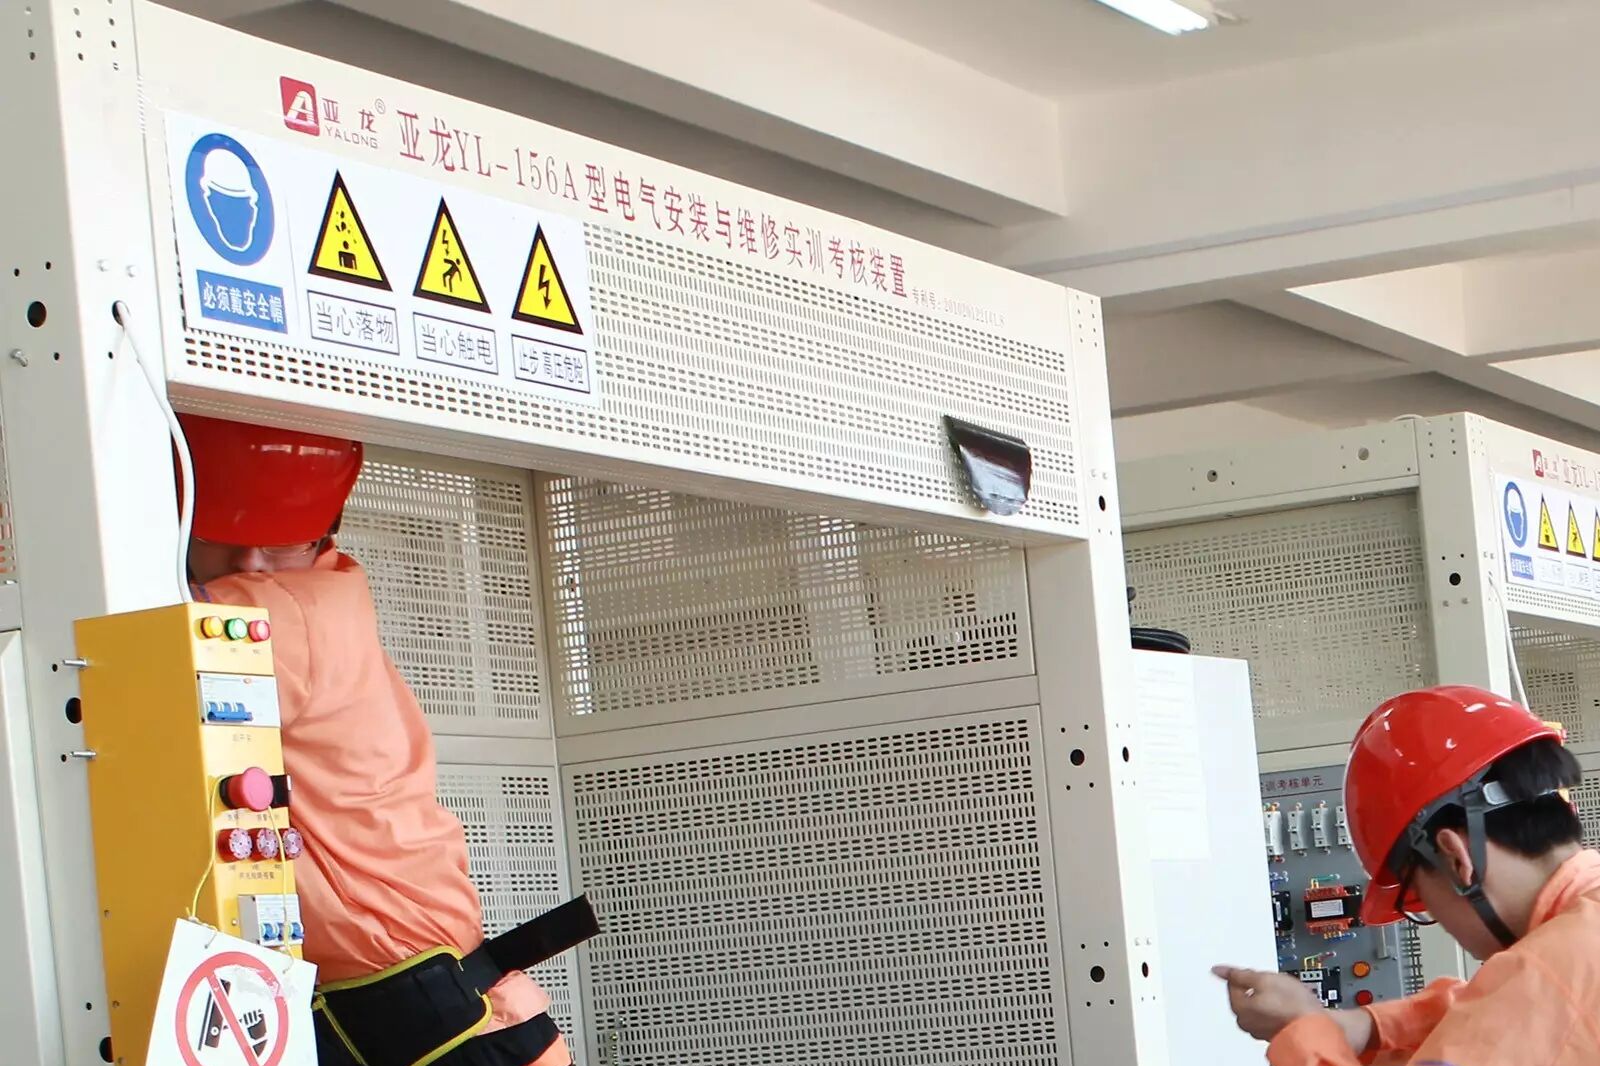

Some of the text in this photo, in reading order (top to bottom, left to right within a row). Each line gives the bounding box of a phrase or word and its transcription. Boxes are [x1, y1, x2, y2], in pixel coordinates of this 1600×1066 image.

[321, 98, 377, 133] 亚龙
[325, 125, 379, 149] YALONG
[203, 281, 284, 324] 必须戴安全帽
[316, 301, 394, 344] 当心落物
[421, 323, 494, 365] 当心触电
[1260, 775, 1324, 792] 训考核单元
